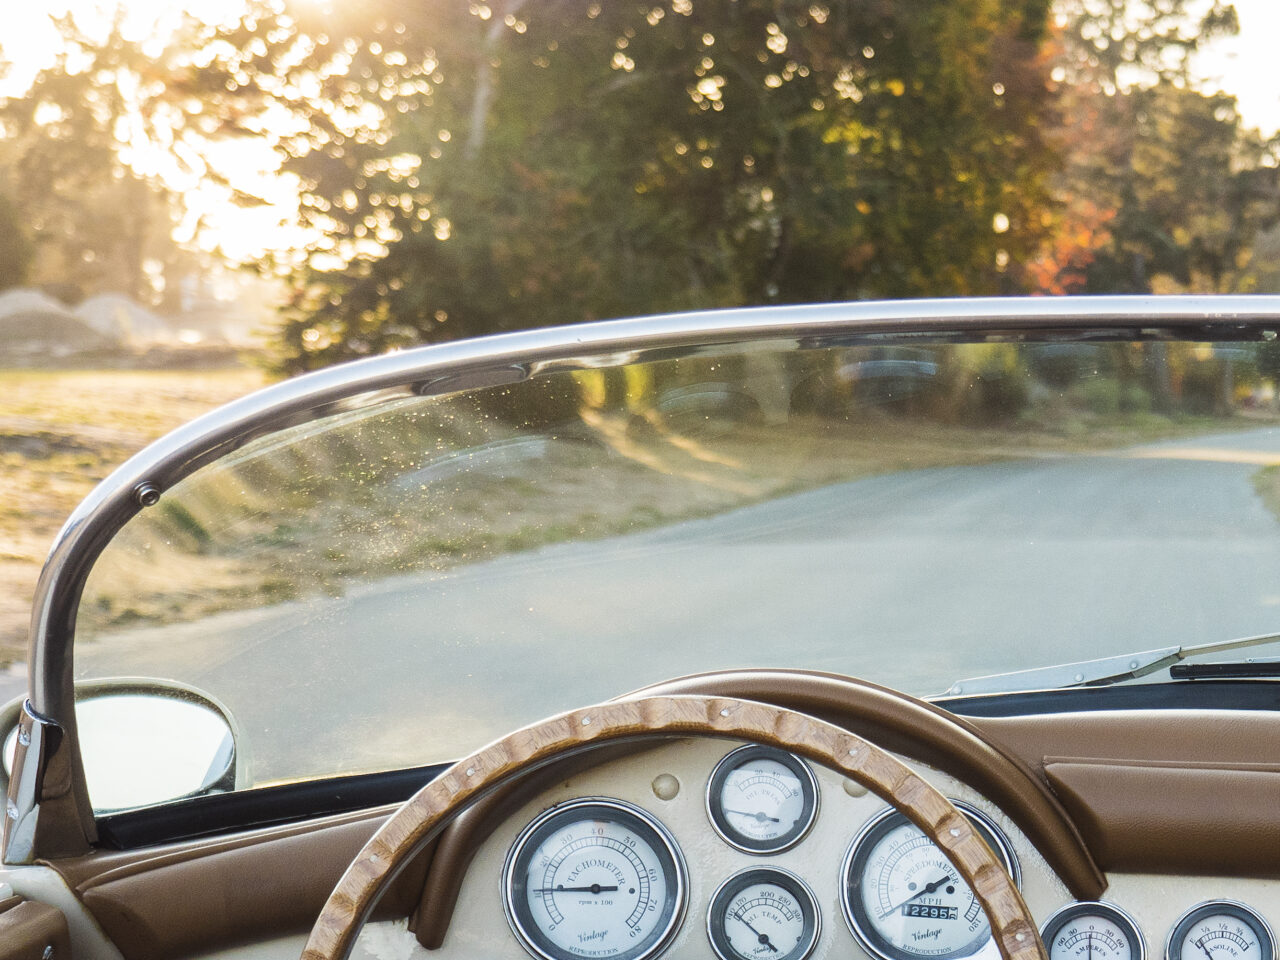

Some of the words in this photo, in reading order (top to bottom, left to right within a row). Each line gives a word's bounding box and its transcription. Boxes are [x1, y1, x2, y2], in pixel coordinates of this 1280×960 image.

[591, 828, 604, 836] 40
[561, 834, 573, 845] 30
[623, 836, 637, 848] 50
[539, 855, 549, 869] 20
[870, 878, 878, 889] 20
[876, 856, 885, 867] 30
[889, 840, 898, 851] 40
[567, 859, 625, 885] TACHOMETER
[649, 868, 658, 882] 60
[904, 860, 960, 885] SPEEDOMETER
[649, 899, 658, 912] 70
[726, 907, 736, 921] 140
[735, 897, 747, 907] 170
[779, 896, 792, 906] 230
[919, 897, 943, 906] MPH
[747, 913, 757, 925] OIL
[762, 911, 782, 925] TEMP
[577, 929, 609, 943] Vintage
[629, 925, 642, 938] 80
[912, 928, 943, 942] Vintage
[1057, 937, 1066, 947] 60
[1068, 928, 1078, 937] 30
[1105, 929, 1114, 938] 30
[1116, 938, 1125, 949] 60
[1189, 937, 1196, 945] E
[1219, 923, 1228, 931] 1/2
[569, 945, 619, 957] REPRODUCTION
[742, 951, 785, 960] REPRODUCTION
[902, 944, 952, 956] REPRODUCTION
[1075, 944, 1107, 957] AMPERES
